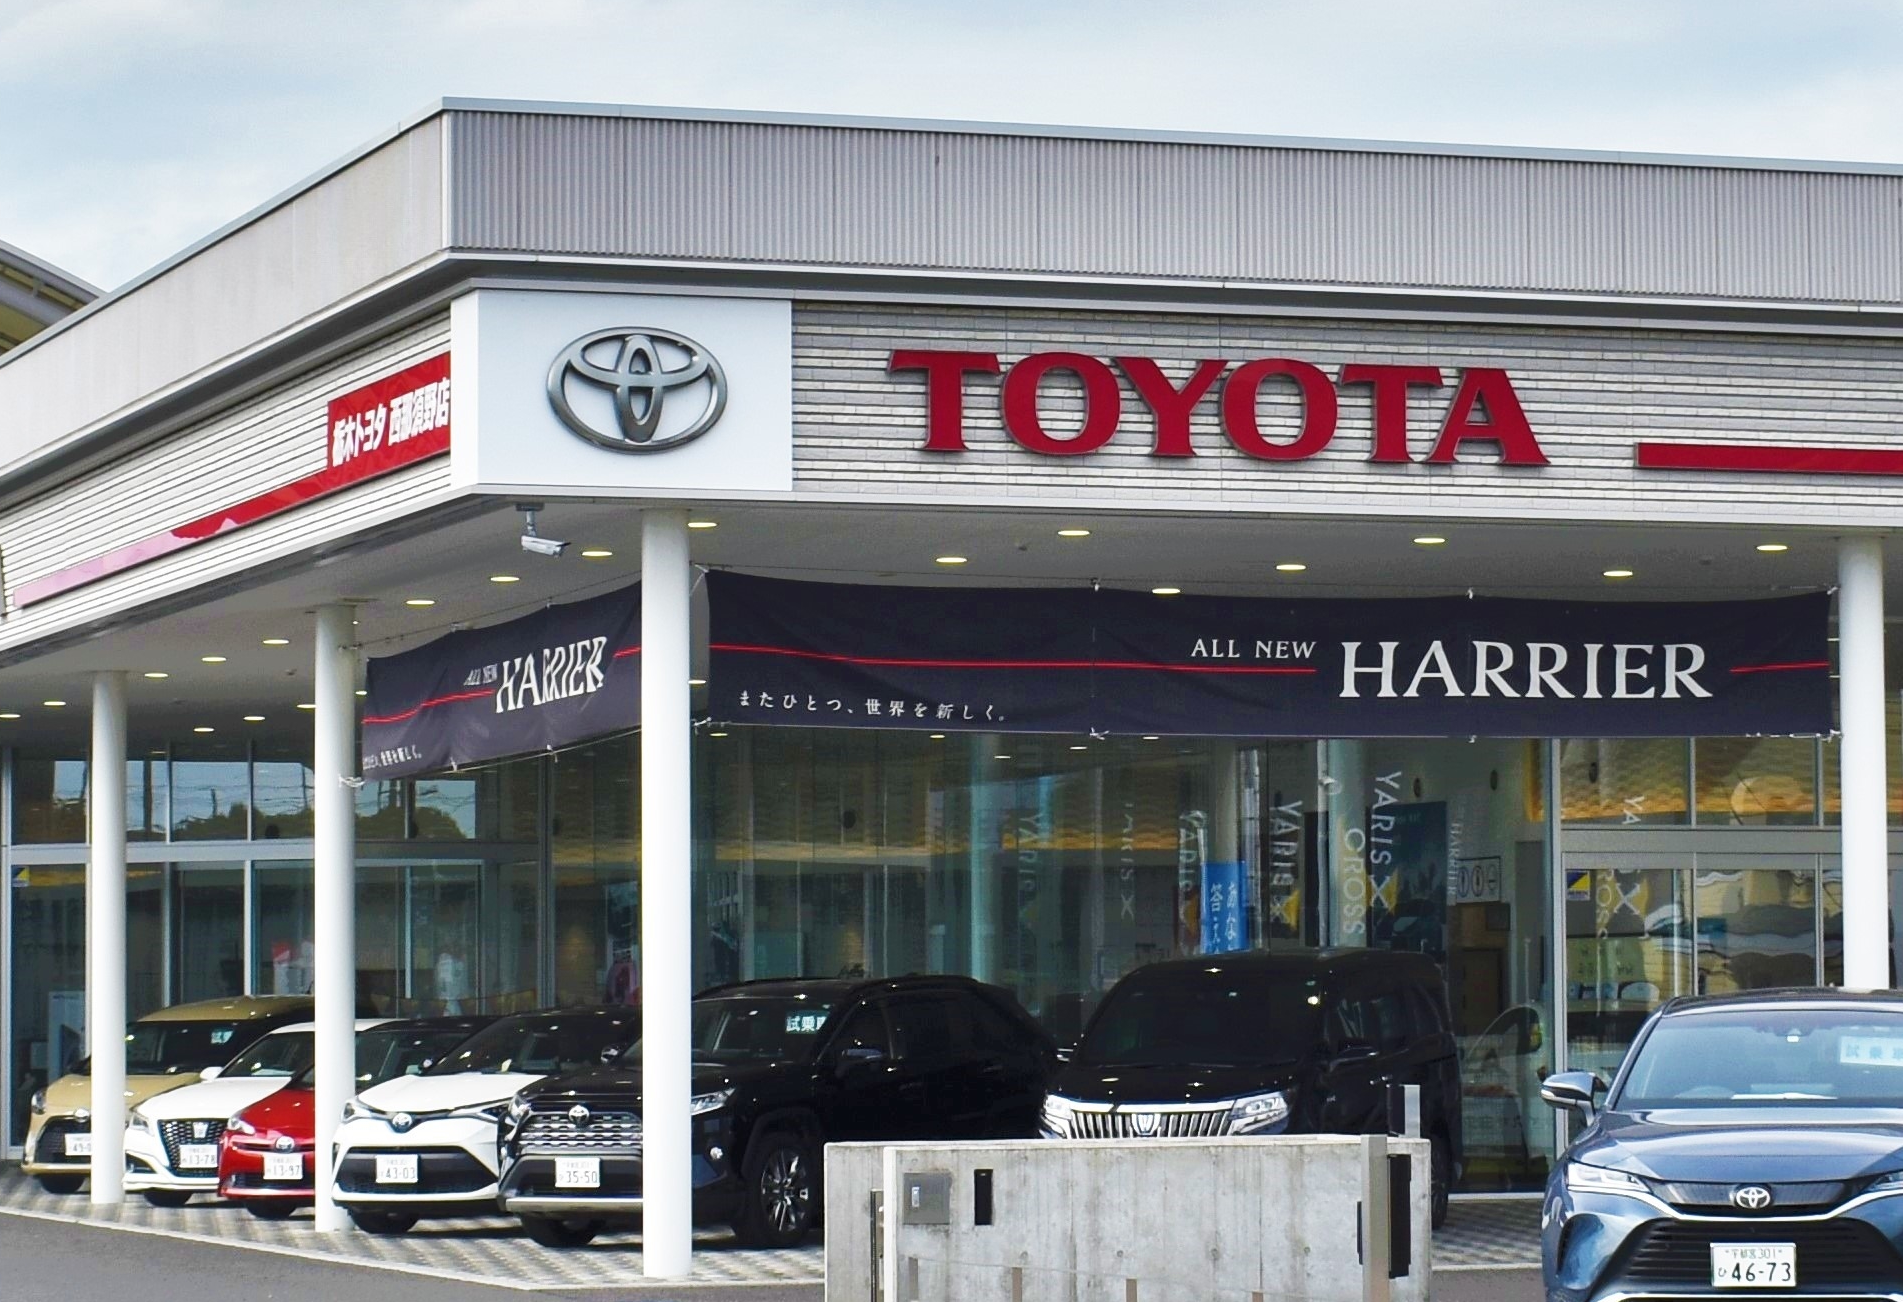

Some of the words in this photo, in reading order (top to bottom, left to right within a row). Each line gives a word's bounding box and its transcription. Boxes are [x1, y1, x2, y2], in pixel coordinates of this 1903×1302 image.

[332, 403, 387, 467] 栃木トヨタ
[388, 377, 450, 446] 西那須野店
[887, 350, 1552, 466] TOYOTA
[496, 636, 607, 714] HARRIER
[739, 690, 1005, 722] またひとつ、世界を新しく。
[1191, 638, 1240, 658] ALL
[1255, 640, 1316, 659] NEW
[1339, 640, 1713, 699] HARRIER
[1369, 771, 1402, 865] YARIS
[1342, 828, 1366, 934] CROSS
[1731, 1262, 1791, 1282] 46-73
